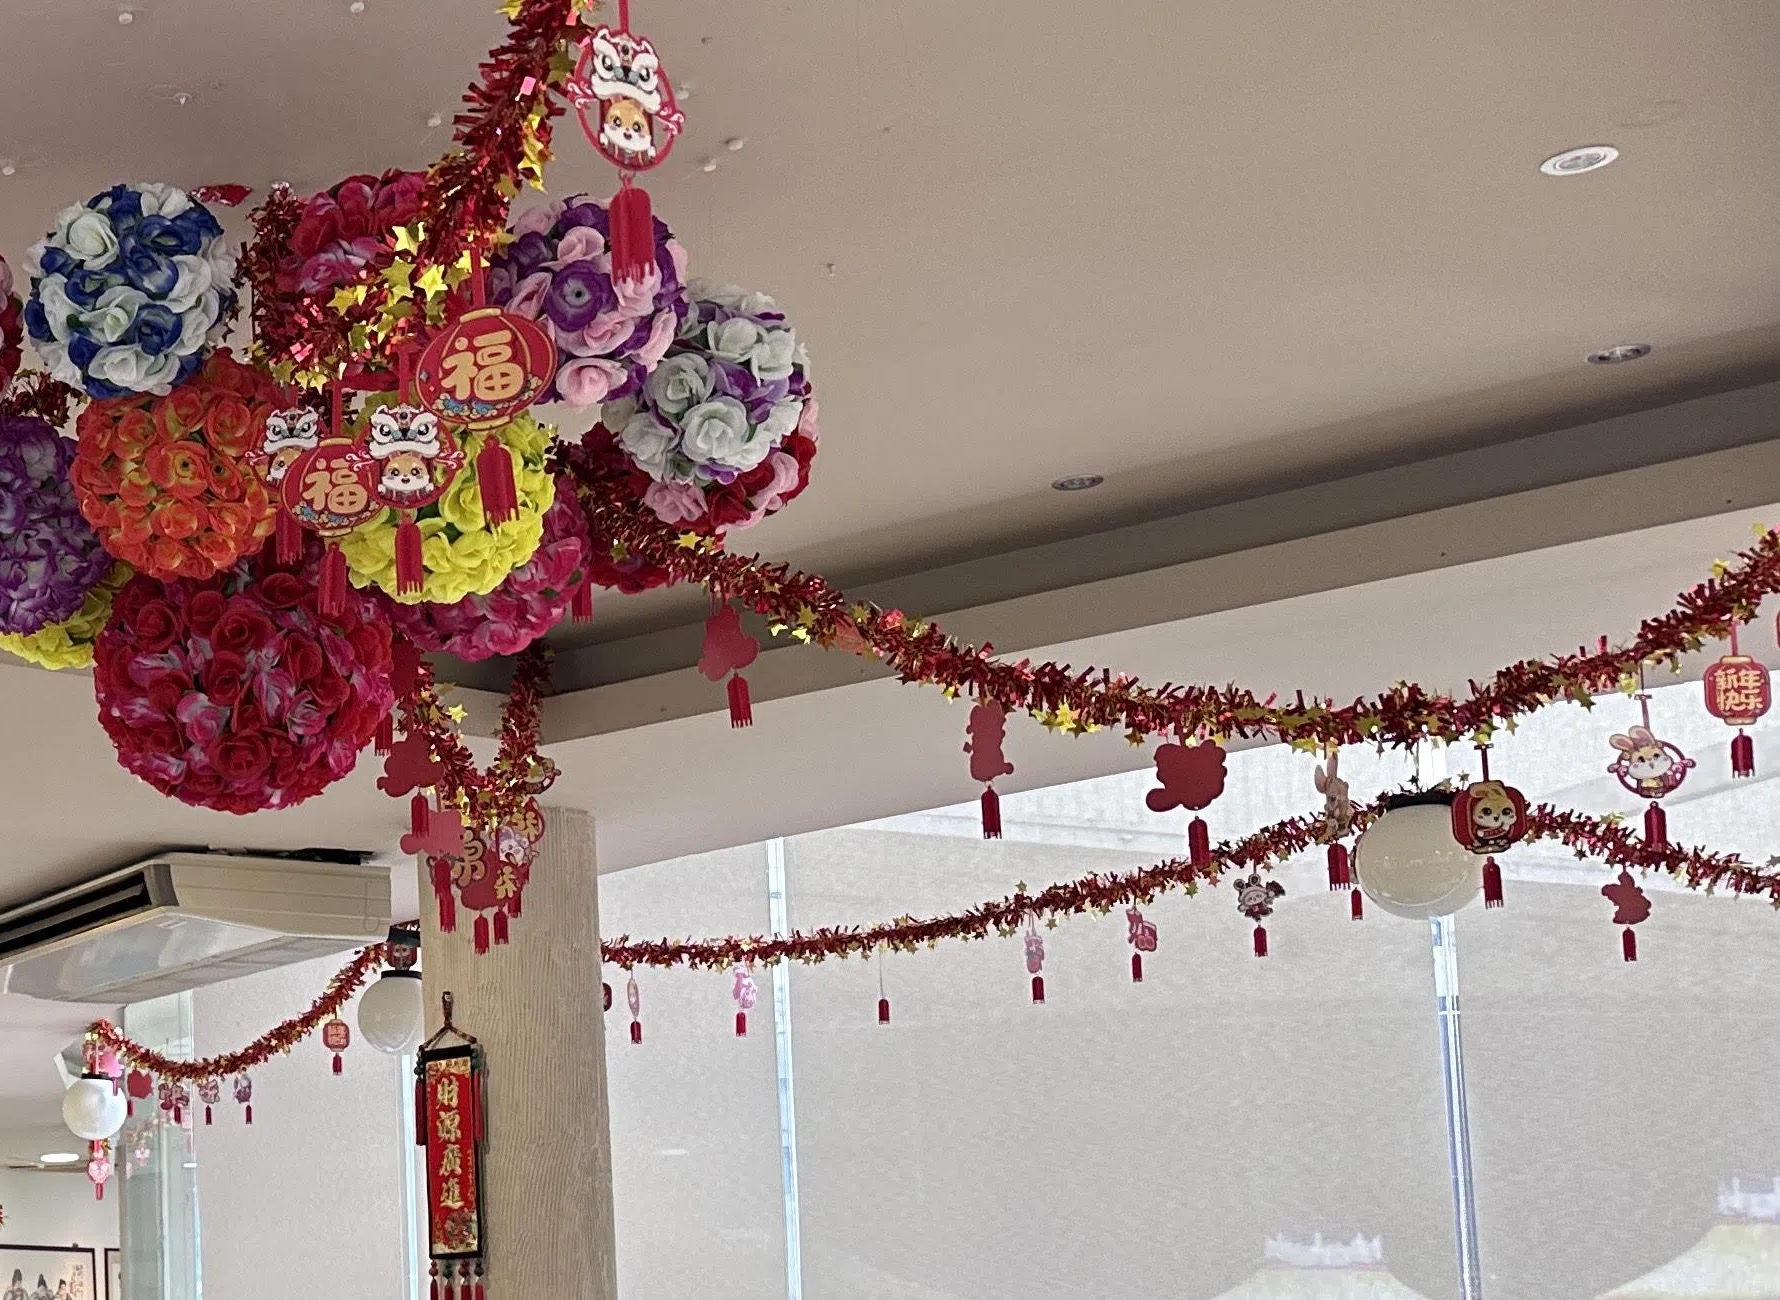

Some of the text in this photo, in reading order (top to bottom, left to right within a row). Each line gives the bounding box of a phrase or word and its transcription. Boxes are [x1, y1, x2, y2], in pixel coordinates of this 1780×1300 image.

[442, 332, 525, 400] 福
[302, 457, 369, 514] 福
[1714, 668, 1761, 691] 新年
[1716, 689, 1763, 712] 快乐
